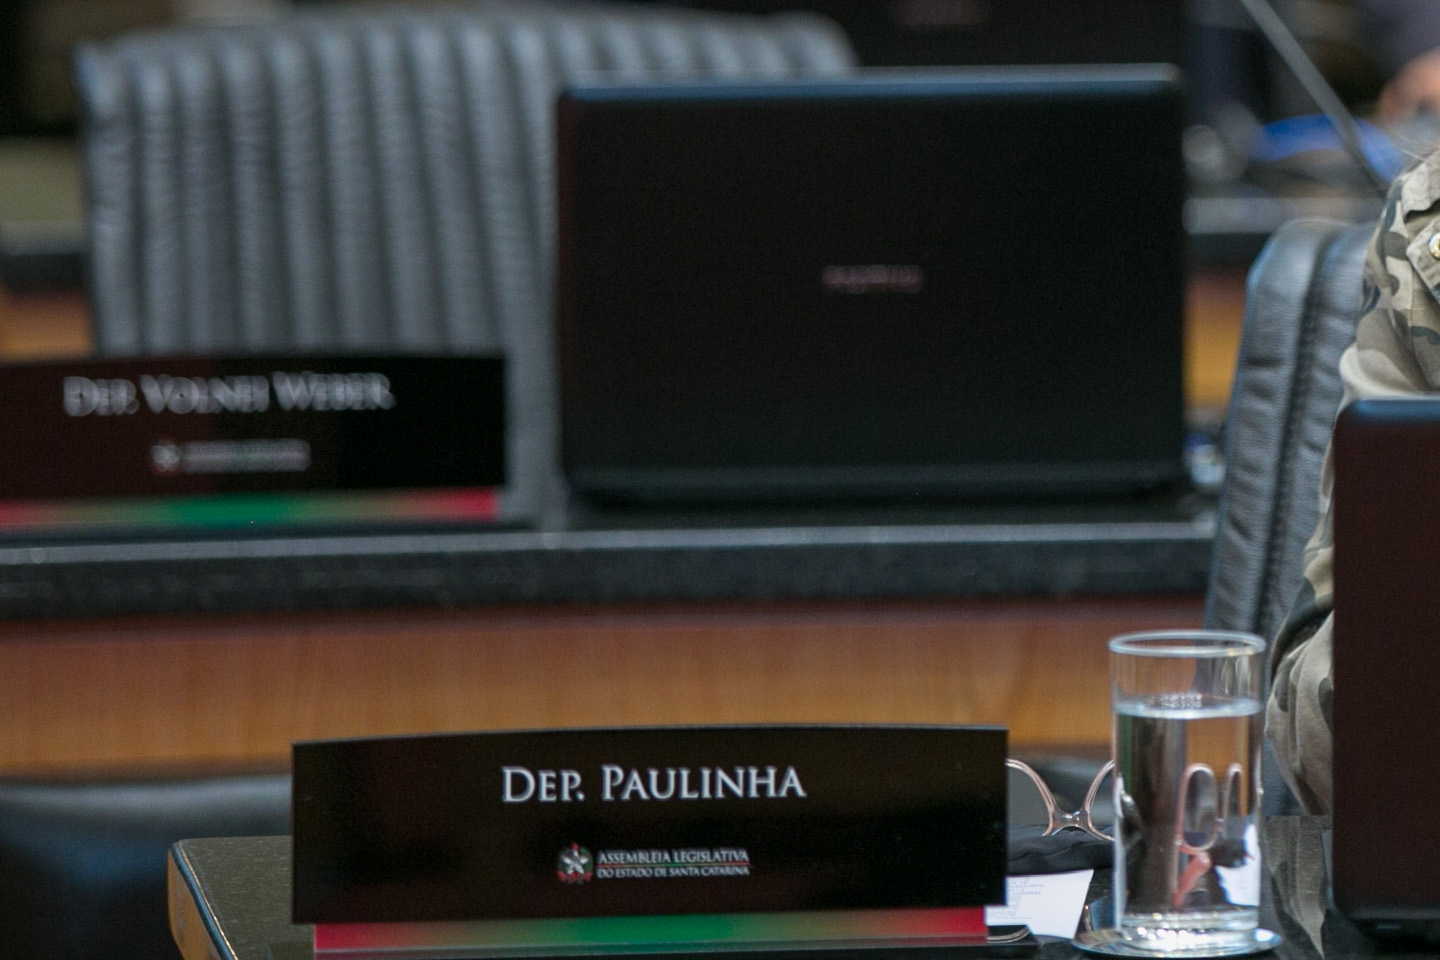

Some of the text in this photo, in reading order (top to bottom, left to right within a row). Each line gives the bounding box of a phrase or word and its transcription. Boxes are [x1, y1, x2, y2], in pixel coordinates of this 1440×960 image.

[502, 763, 807, 803] DEP. PAULINHA
[597, 848, 750, 864] ASSEMBLEIA LEGISLATIVA
[597, 865, 750, 879] DO ESTADO DE SANTA CATARINA
